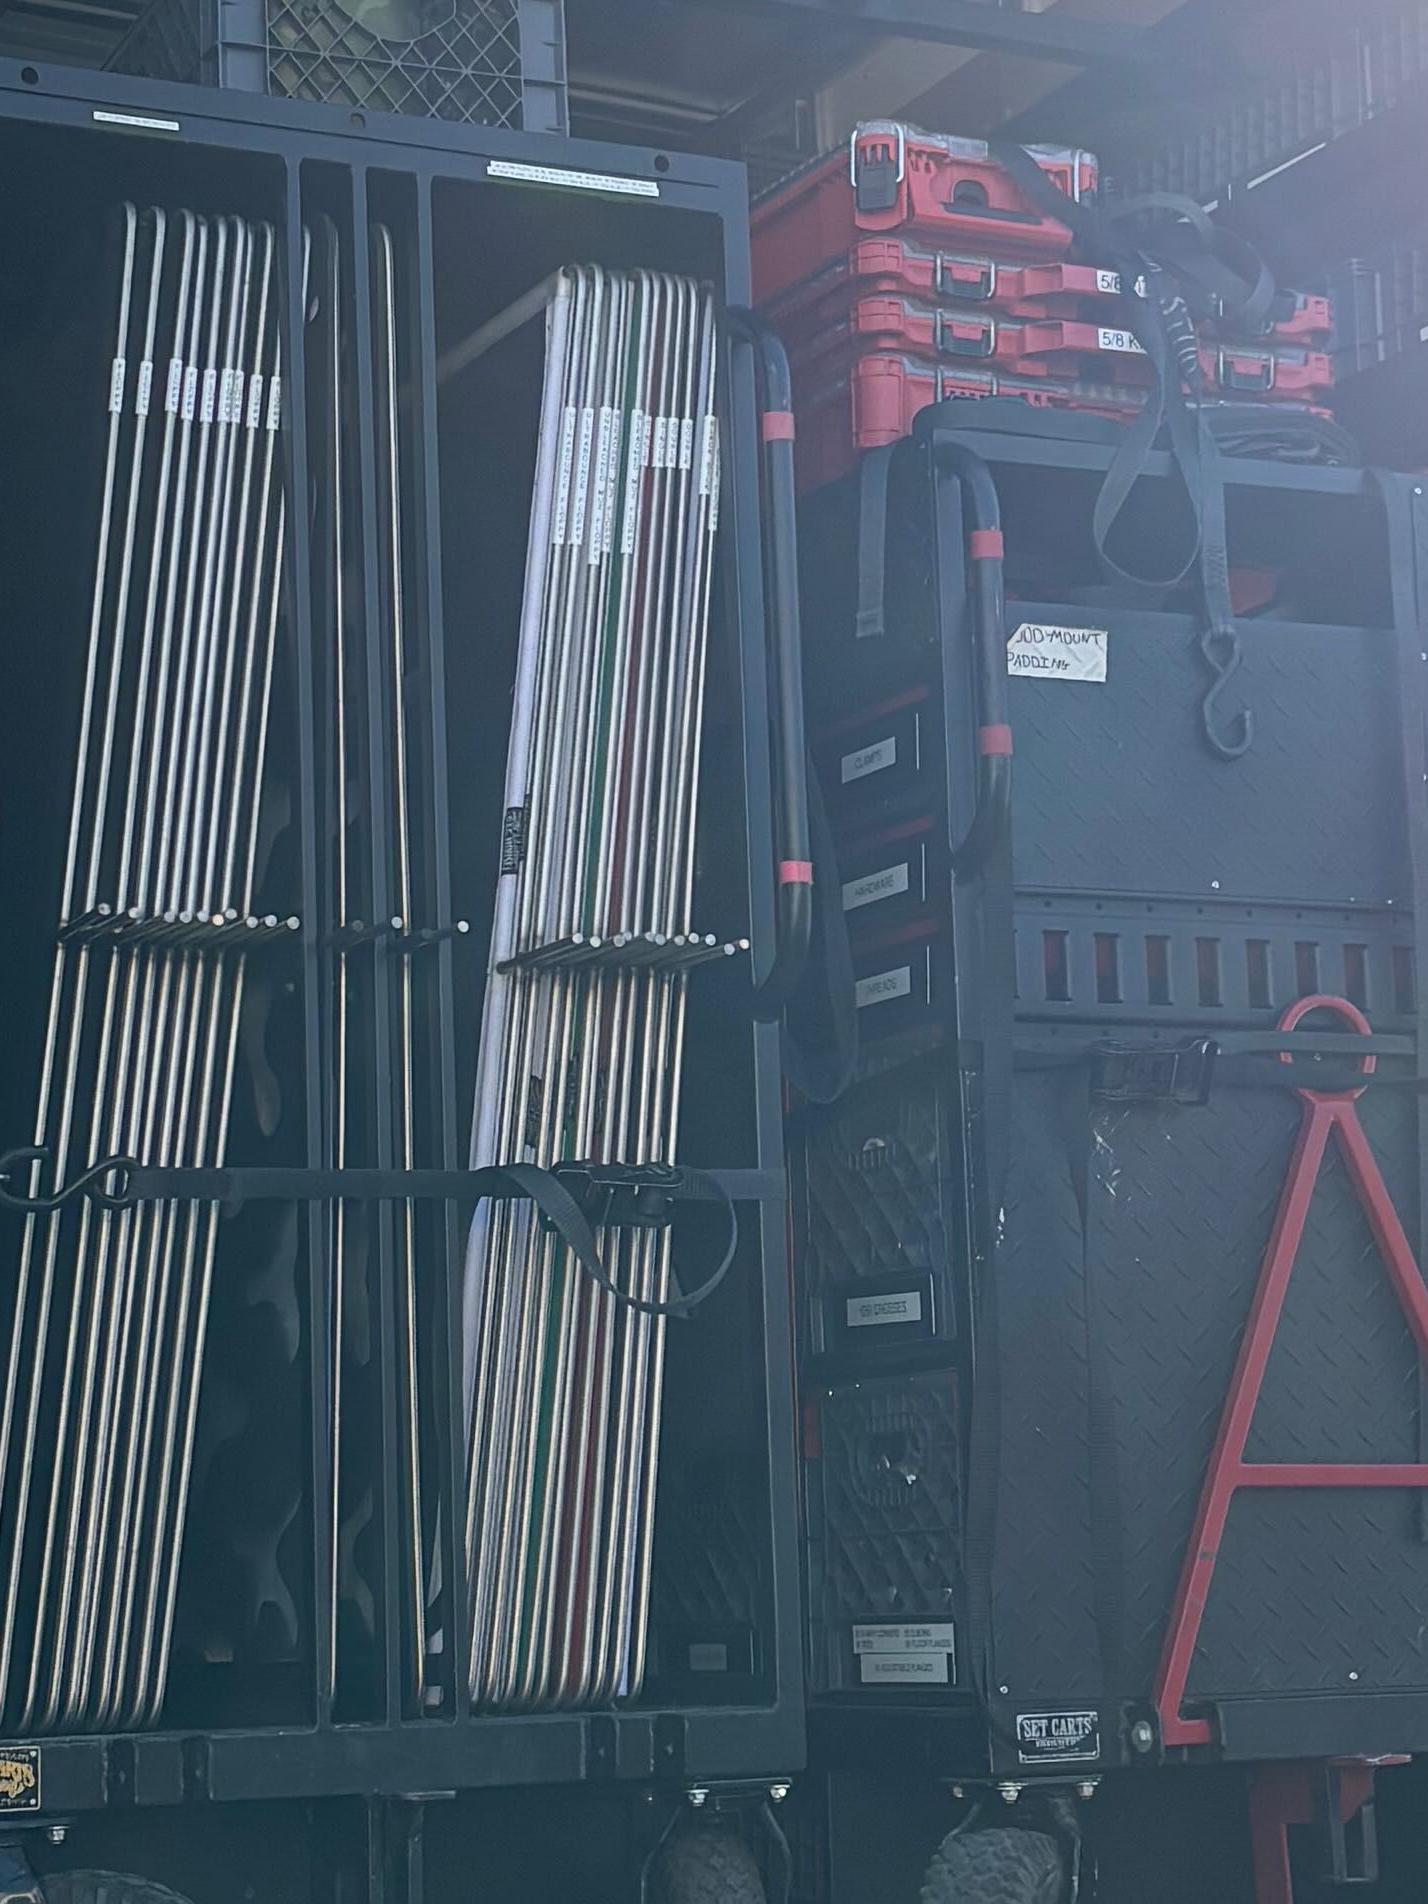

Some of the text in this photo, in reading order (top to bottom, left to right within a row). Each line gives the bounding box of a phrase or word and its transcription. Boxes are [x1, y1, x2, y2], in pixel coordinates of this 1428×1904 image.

[1102, 331, 1124, 347] 5/8
[1022, 1716, 1093, 1738] SET CARTS
